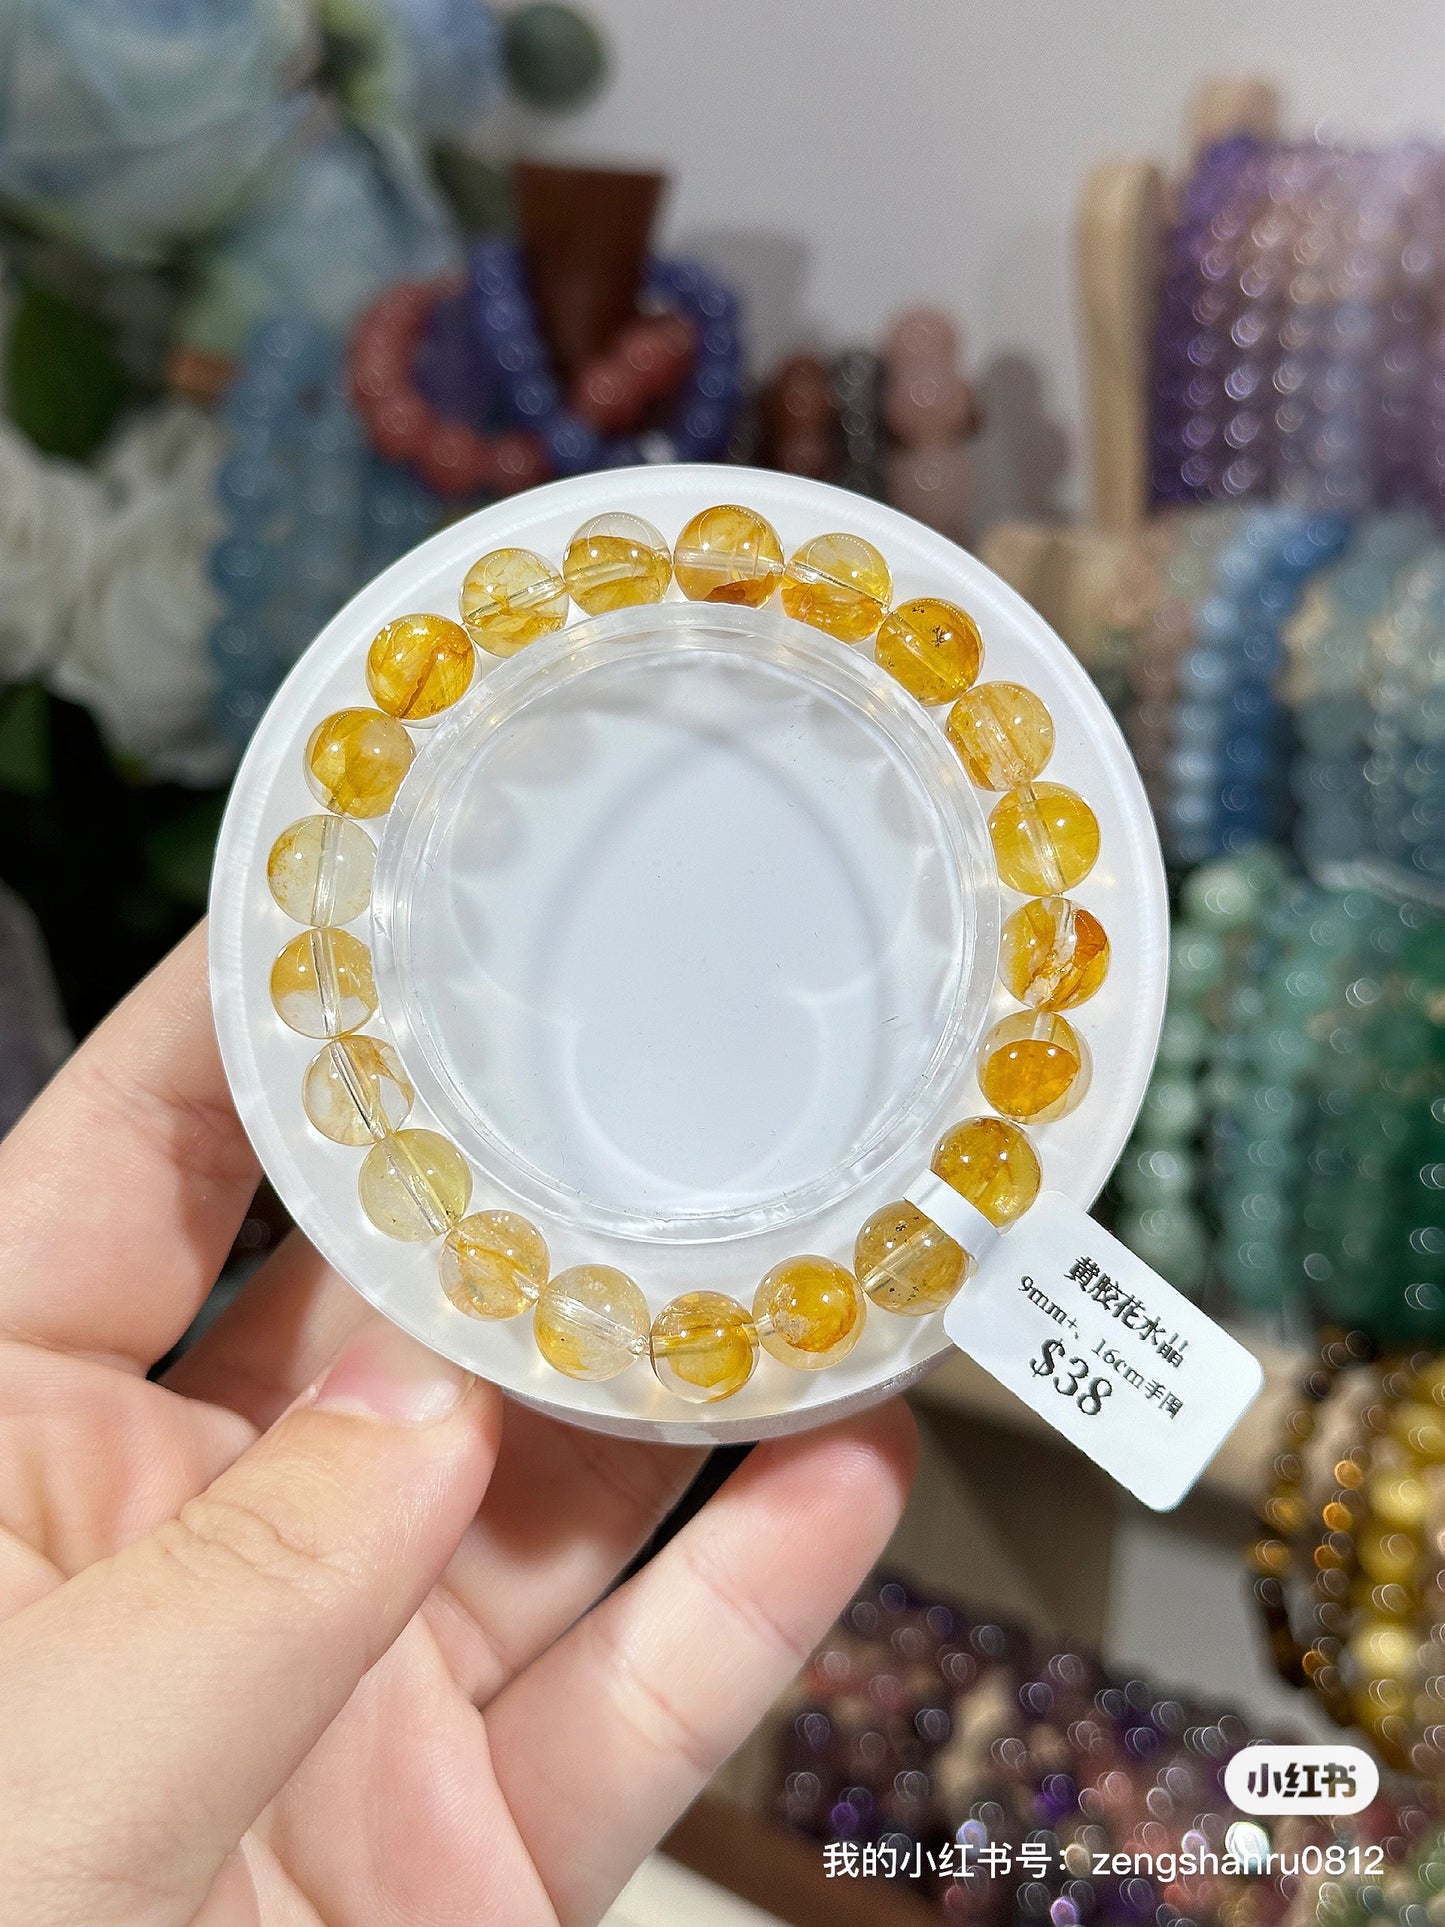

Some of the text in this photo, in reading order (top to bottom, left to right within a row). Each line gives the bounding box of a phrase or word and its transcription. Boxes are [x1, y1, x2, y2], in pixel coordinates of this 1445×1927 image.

[1063, 1255, 1189, 1369] 黄胶花水晶
[1029, 1338, 1113, 1416] $38
